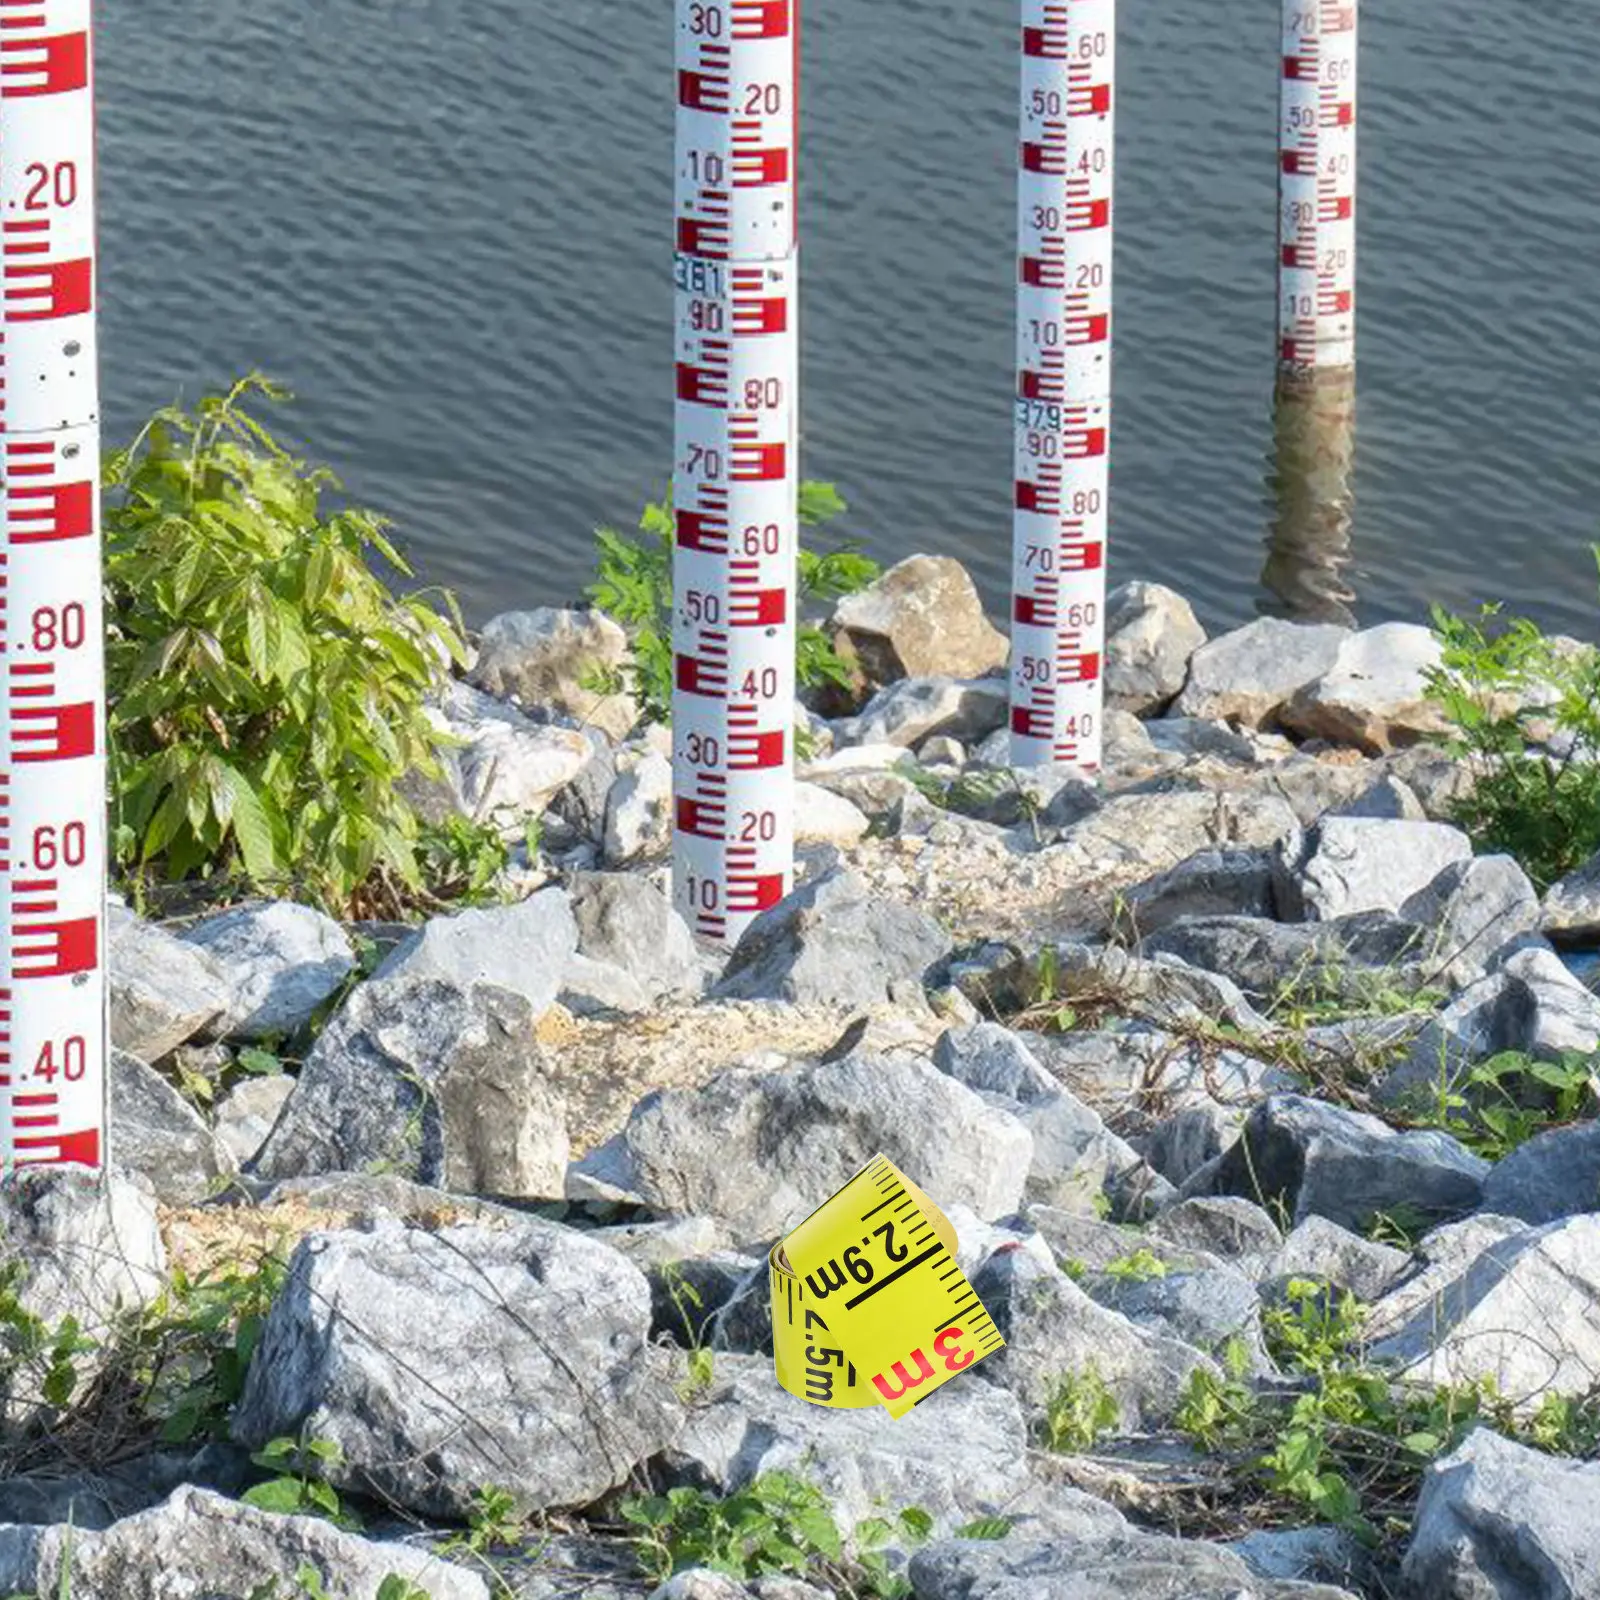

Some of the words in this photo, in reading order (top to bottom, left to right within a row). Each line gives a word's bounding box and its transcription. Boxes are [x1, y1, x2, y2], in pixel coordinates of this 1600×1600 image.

[734, 84, 780, 114] .20
[10, 161, 77, 210] .20
[734, 378, 780, 409] .80
[734, 524, 779, 556] .60
[17, 601, 85, 651] .80
[732, 667, 777, 699] .40
[678, 731, 719, 767] .30
[729, 811, 776, 842] .20
[18, 821, 86, 871] .60
[19, 1035, 86, 1083] .40
[804, 1221, 909, 1300] 2.9m
